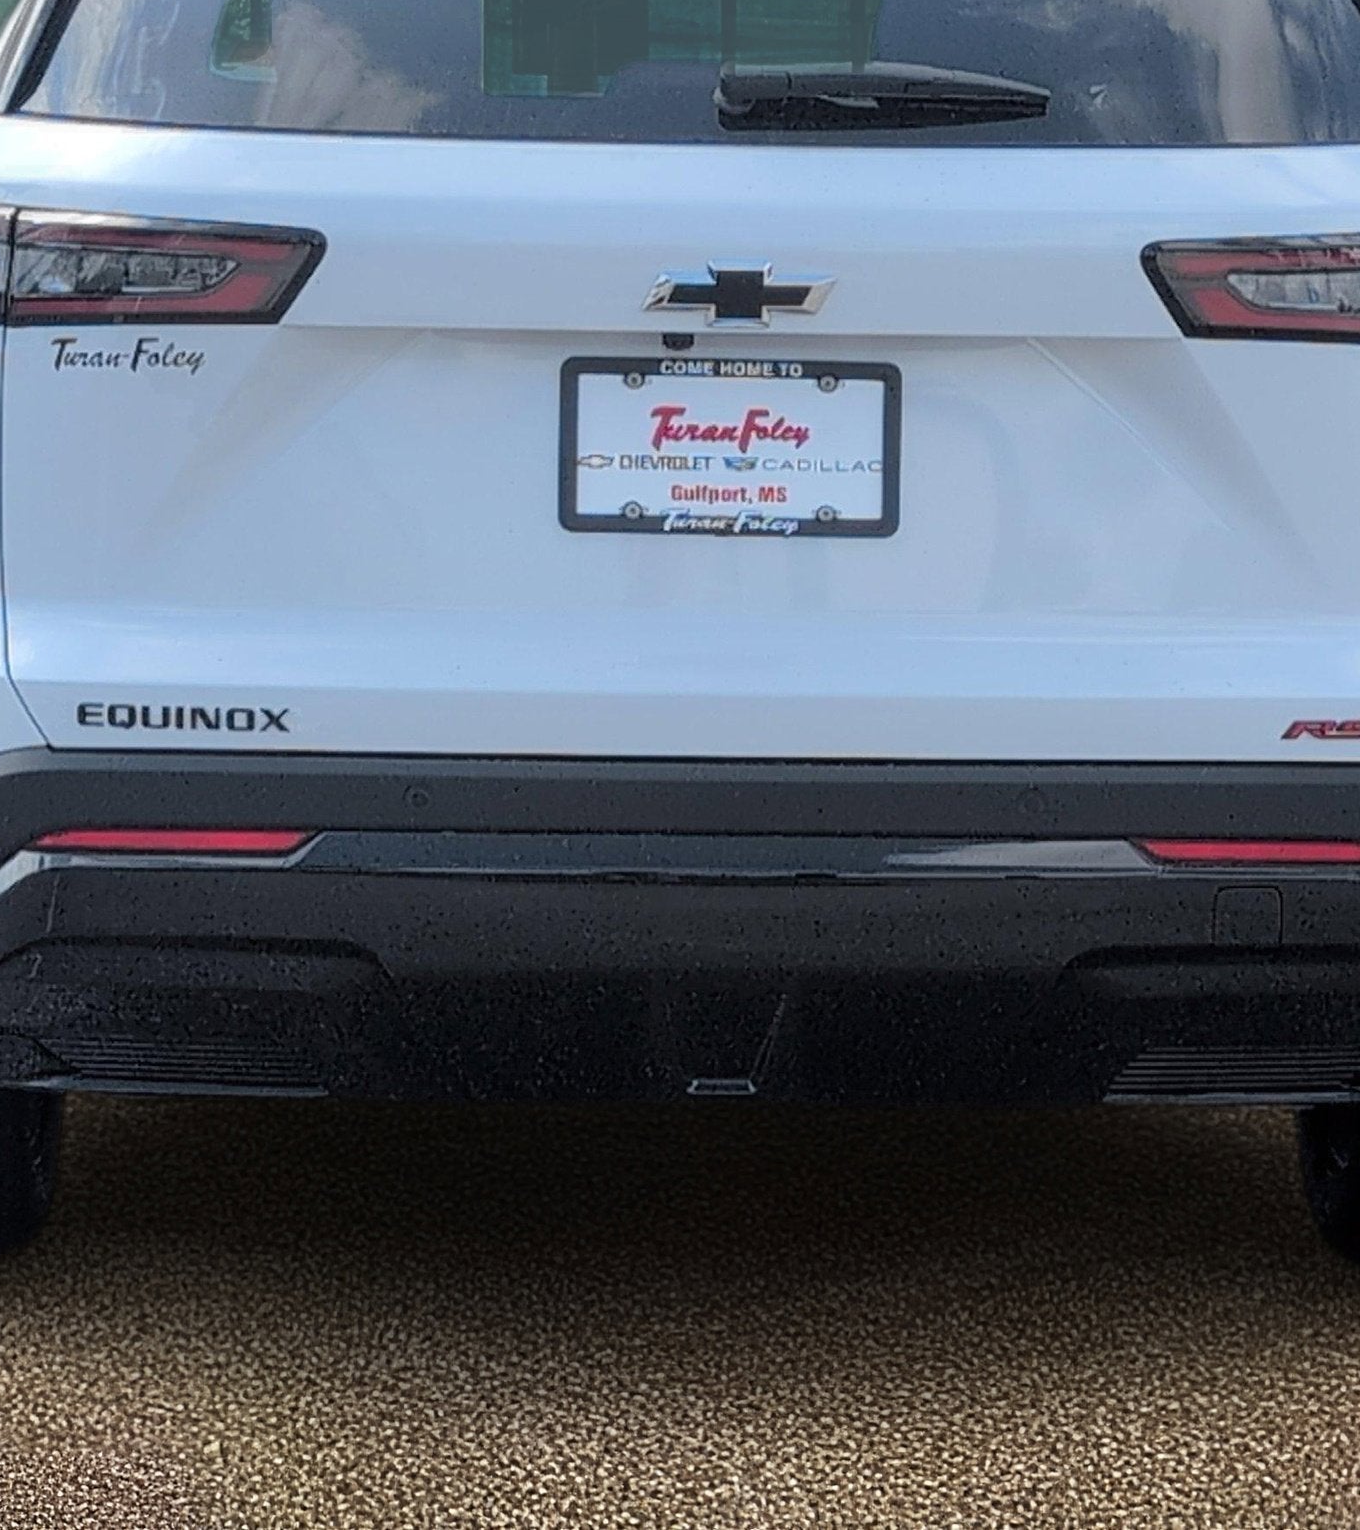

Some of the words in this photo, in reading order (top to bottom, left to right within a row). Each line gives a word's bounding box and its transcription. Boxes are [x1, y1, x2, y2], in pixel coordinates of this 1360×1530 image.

[659, 360, 714, 376] COME
[719, 361, 775, 377] HOME
[779, 362, 803, 377] TO
[762, 458, 883, 472] CADILLAC
[758, 486, 787, 503] MS
[76, 702, 290, 733] EQUINOX
